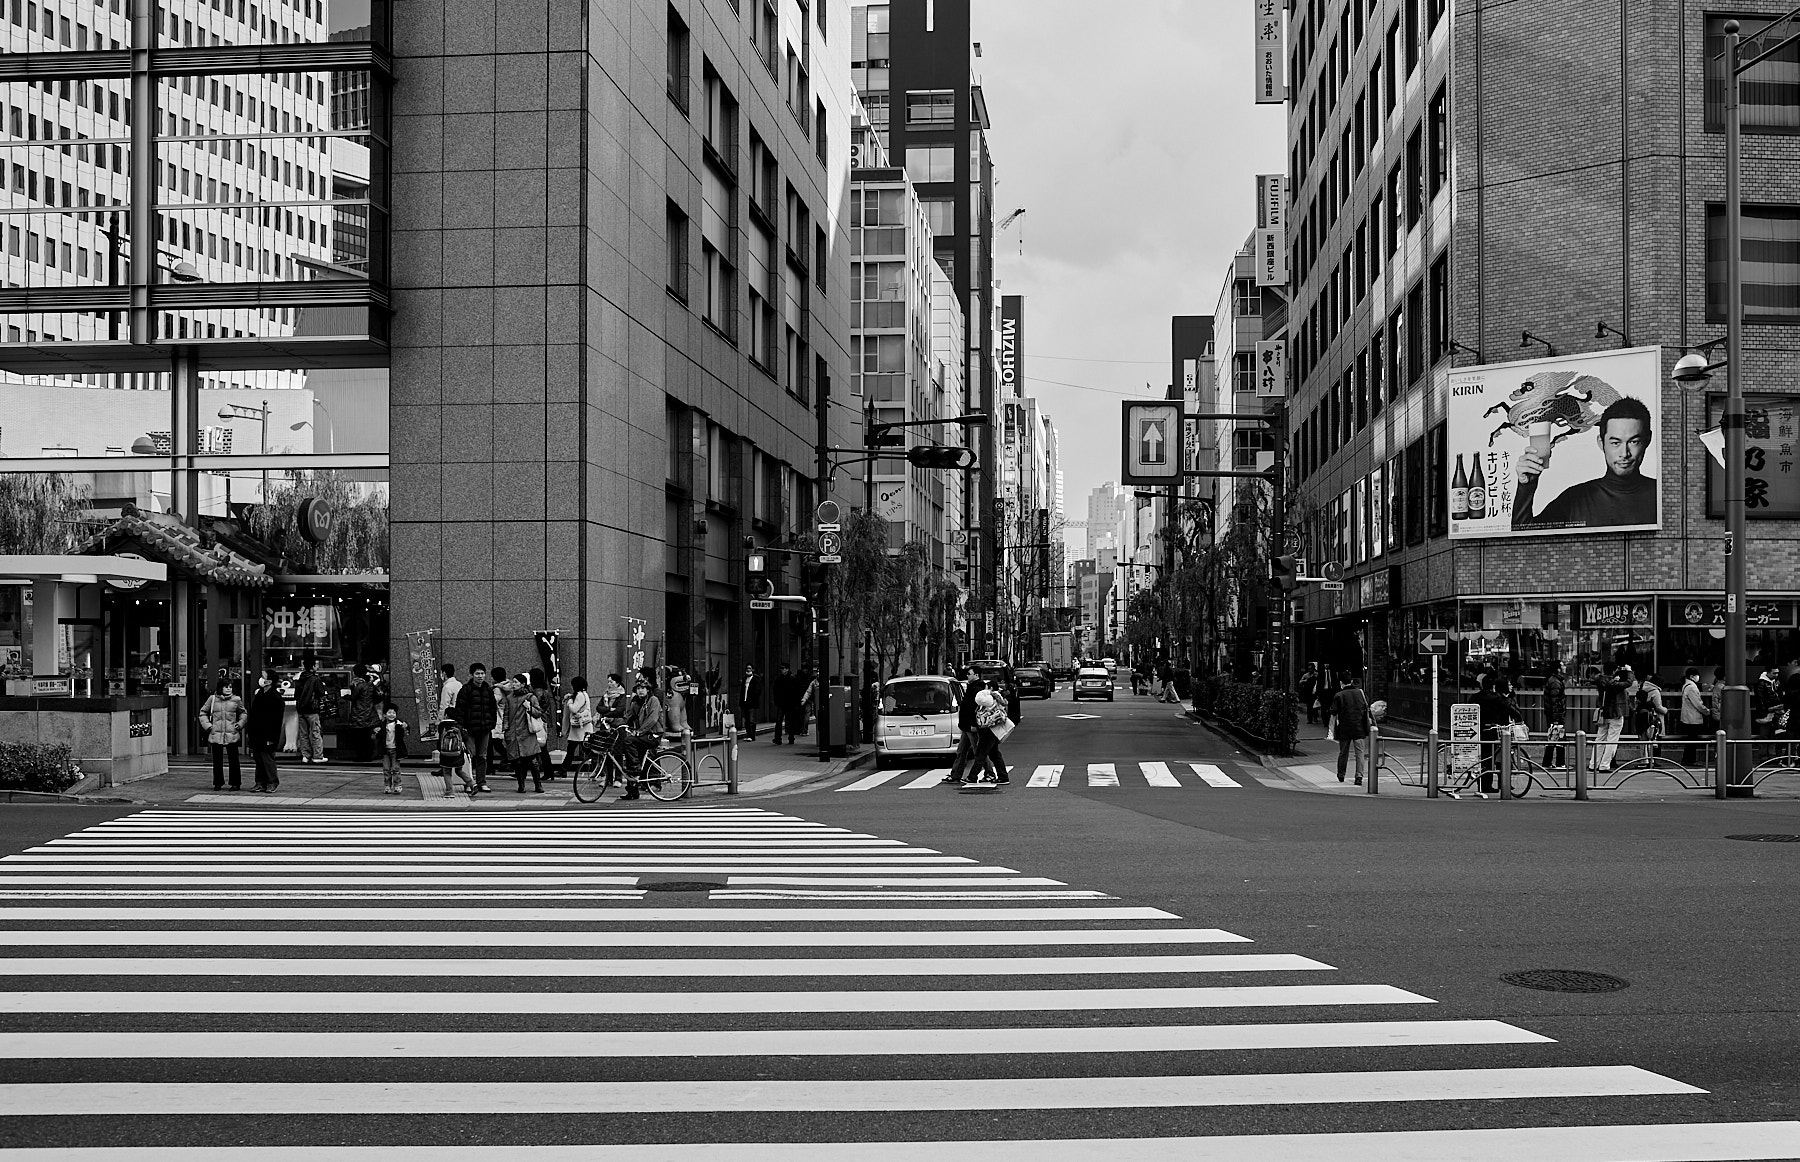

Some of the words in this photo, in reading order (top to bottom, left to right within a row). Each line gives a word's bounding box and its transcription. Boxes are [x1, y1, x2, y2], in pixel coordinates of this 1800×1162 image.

[1270, 178, 1279, 225] FUJIFILM
[1002, 318, 1016, 383] MIZUHO
[1452, 384, 1484, 397] KIRIN
[1779, 408, 1794, 474] 海鮮魚市
[1487, 451, 1499, 518] キリンビール
[823, 538, 833, 553] P
[265, 606, 328, 638] 沖縄
[1712, 614, 1780, 624] ハーガー
